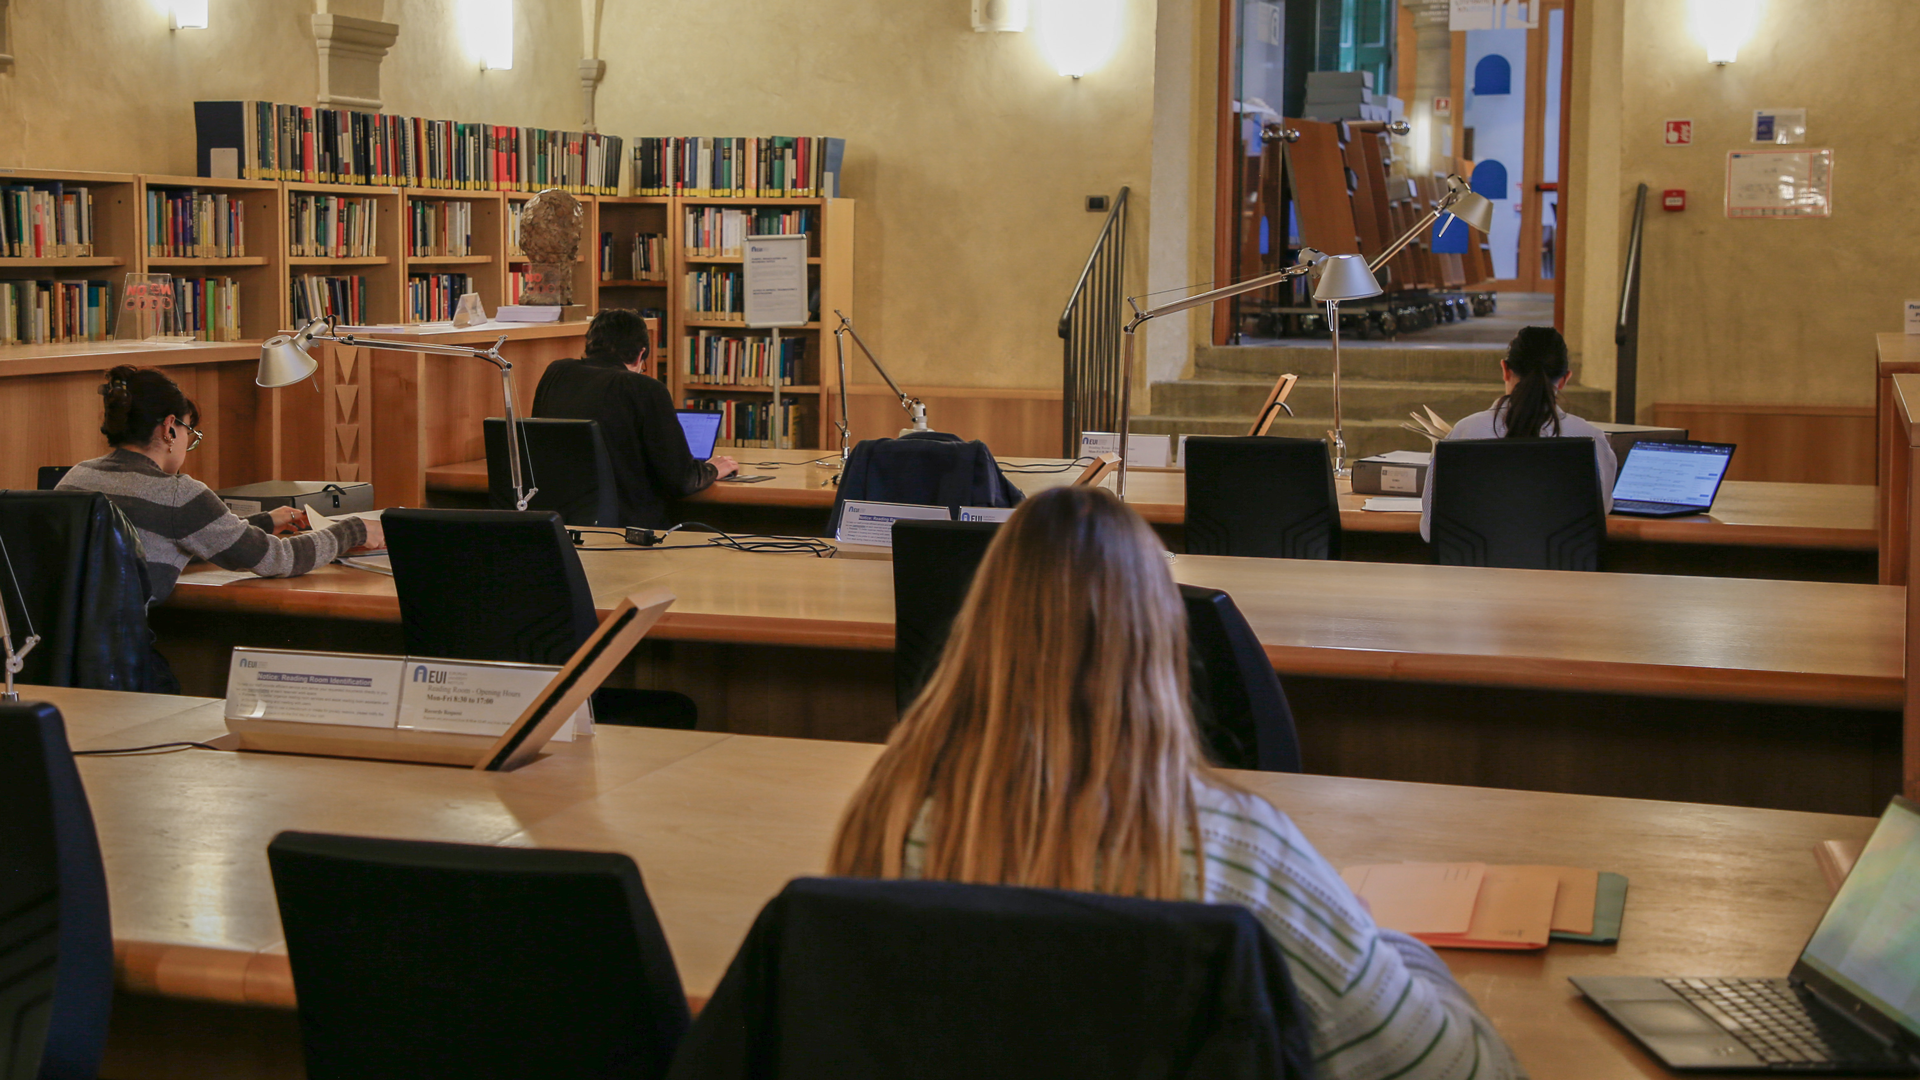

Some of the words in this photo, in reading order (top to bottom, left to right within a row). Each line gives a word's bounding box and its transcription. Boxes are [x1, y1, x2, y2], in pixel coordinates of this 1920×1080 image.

[525, 273, 542, 282] NO
[126, 284, 147, 296] NO
[257, 673, 280, 681] Notice:
[281, 674, 308, 684] Reading
[330, 677, 372, 686] Identification
[428, 670, 447, 684] EUI
[427, 685, 451, 694] Reading
[452, 686, 471, 694] Room
[475, 688, 501, 698] Opening
[502, 689, 521, 698] Hours
[426, 694, 453, 702] Mon-Fri
